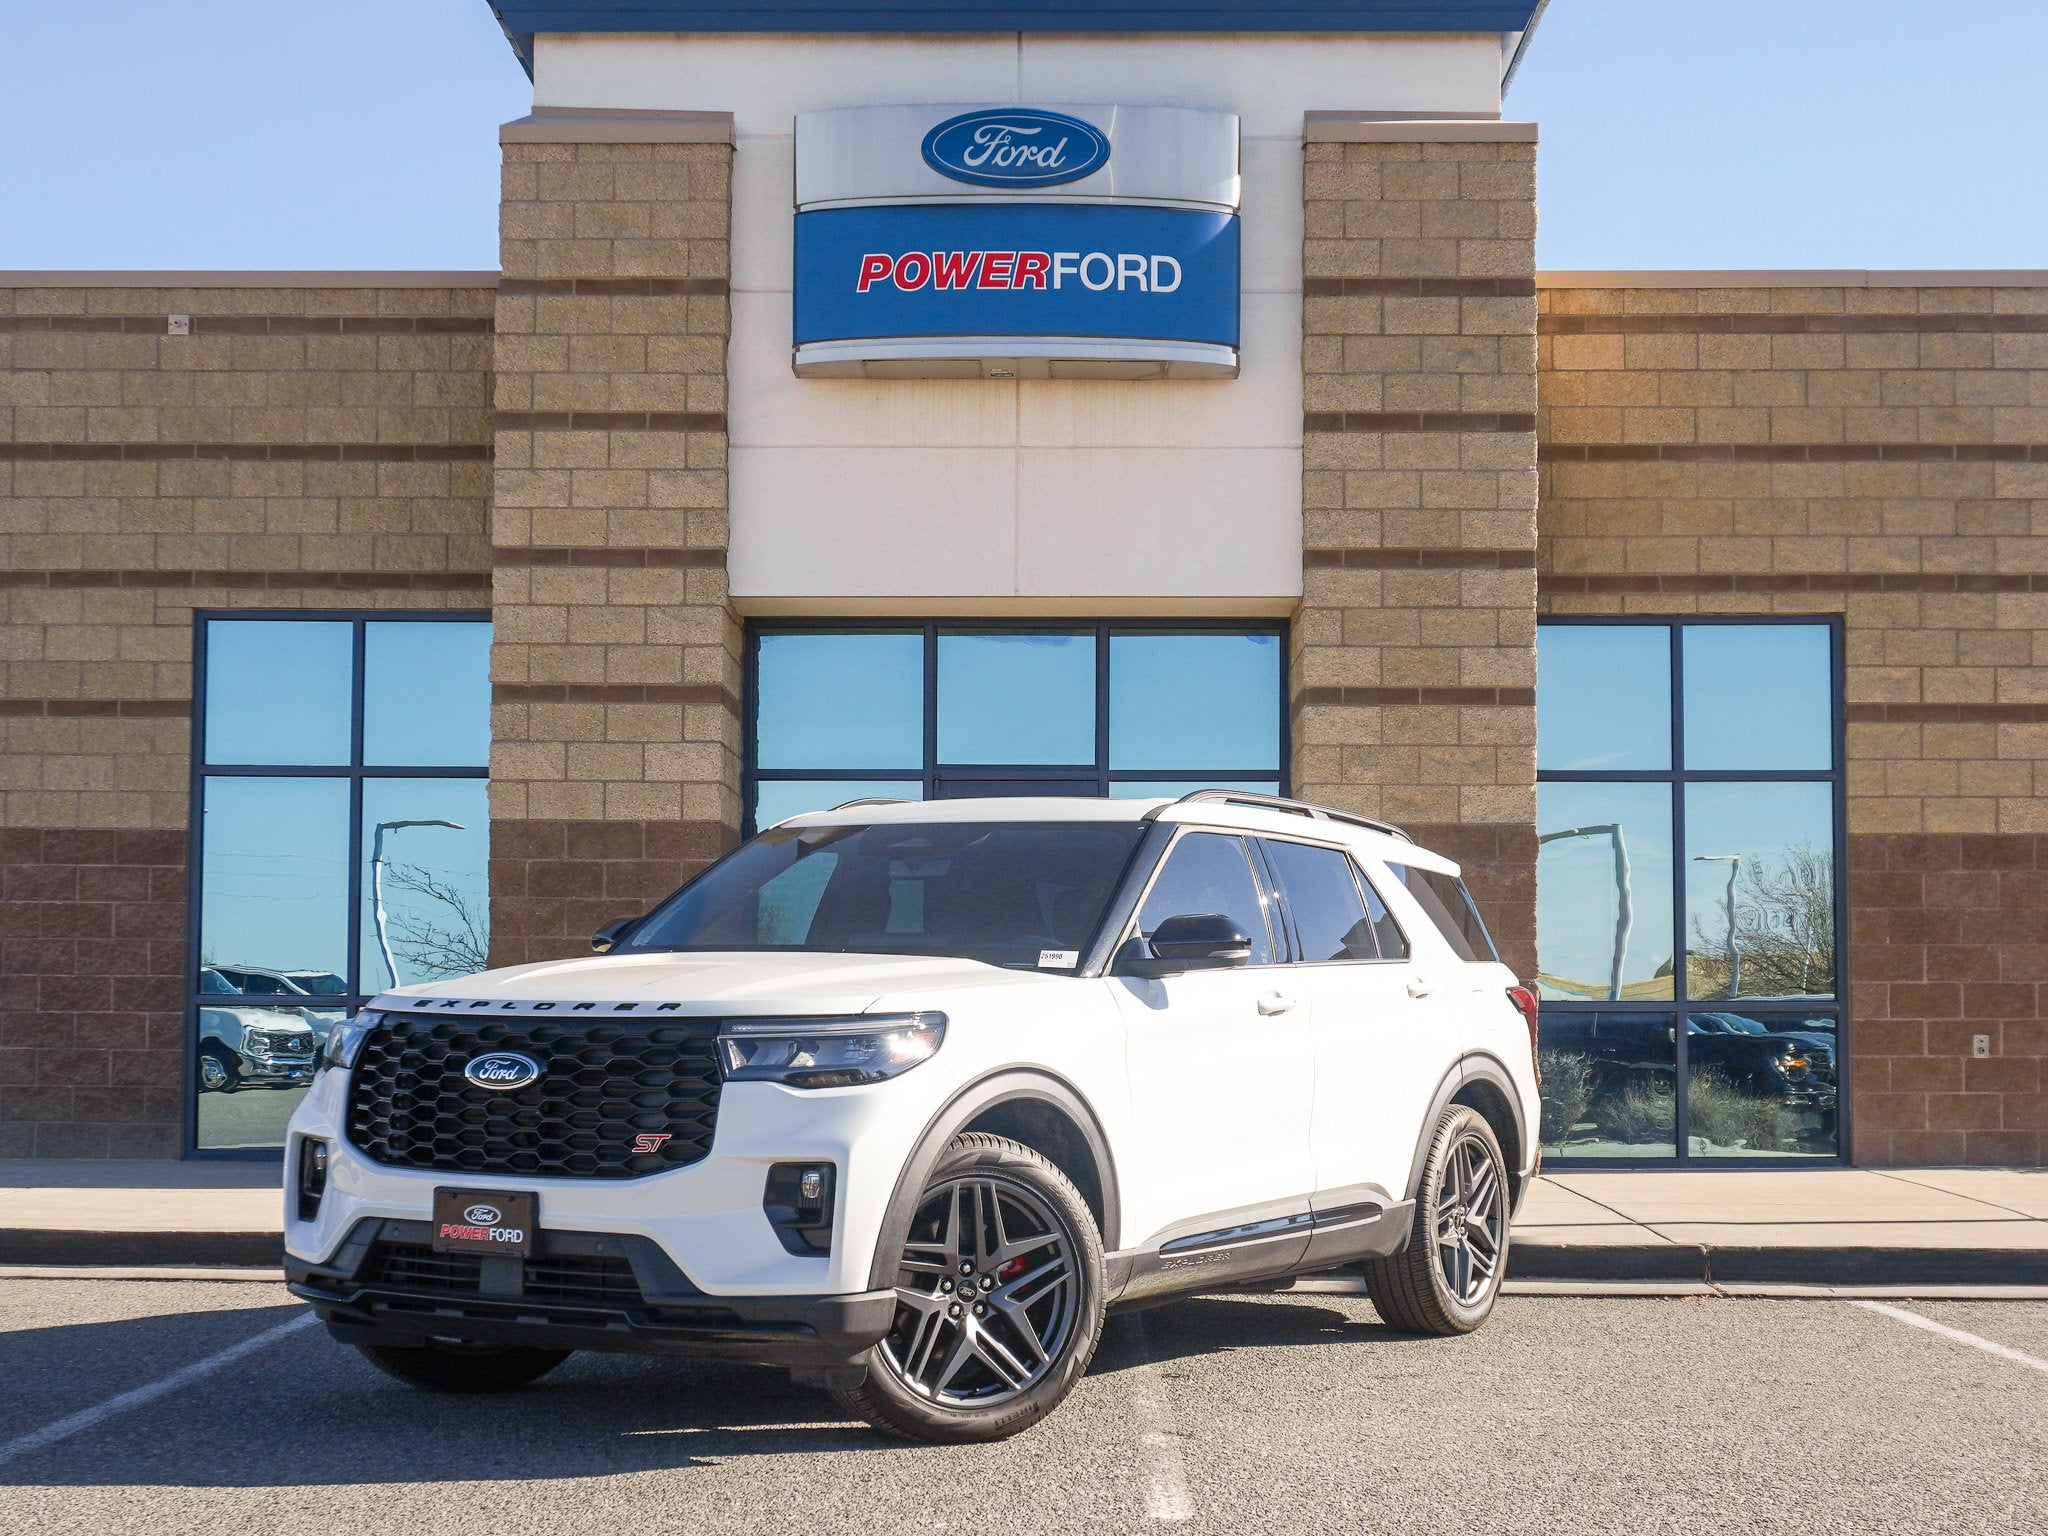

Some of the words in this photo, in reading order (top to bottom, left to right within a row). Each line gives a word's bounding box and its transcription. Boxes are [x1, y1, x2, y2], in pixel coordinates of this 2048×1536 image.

[963, 124, 1069, 168] Ford
[856, 251, 1182, 293] POWERFORD
[413, 999, 681, 1011] EXPLORER
[478, 1059, 519, 1081] Ford
[631, 1133, 672, 1153] ST
[470, 1208, 494, 1221] Ford
